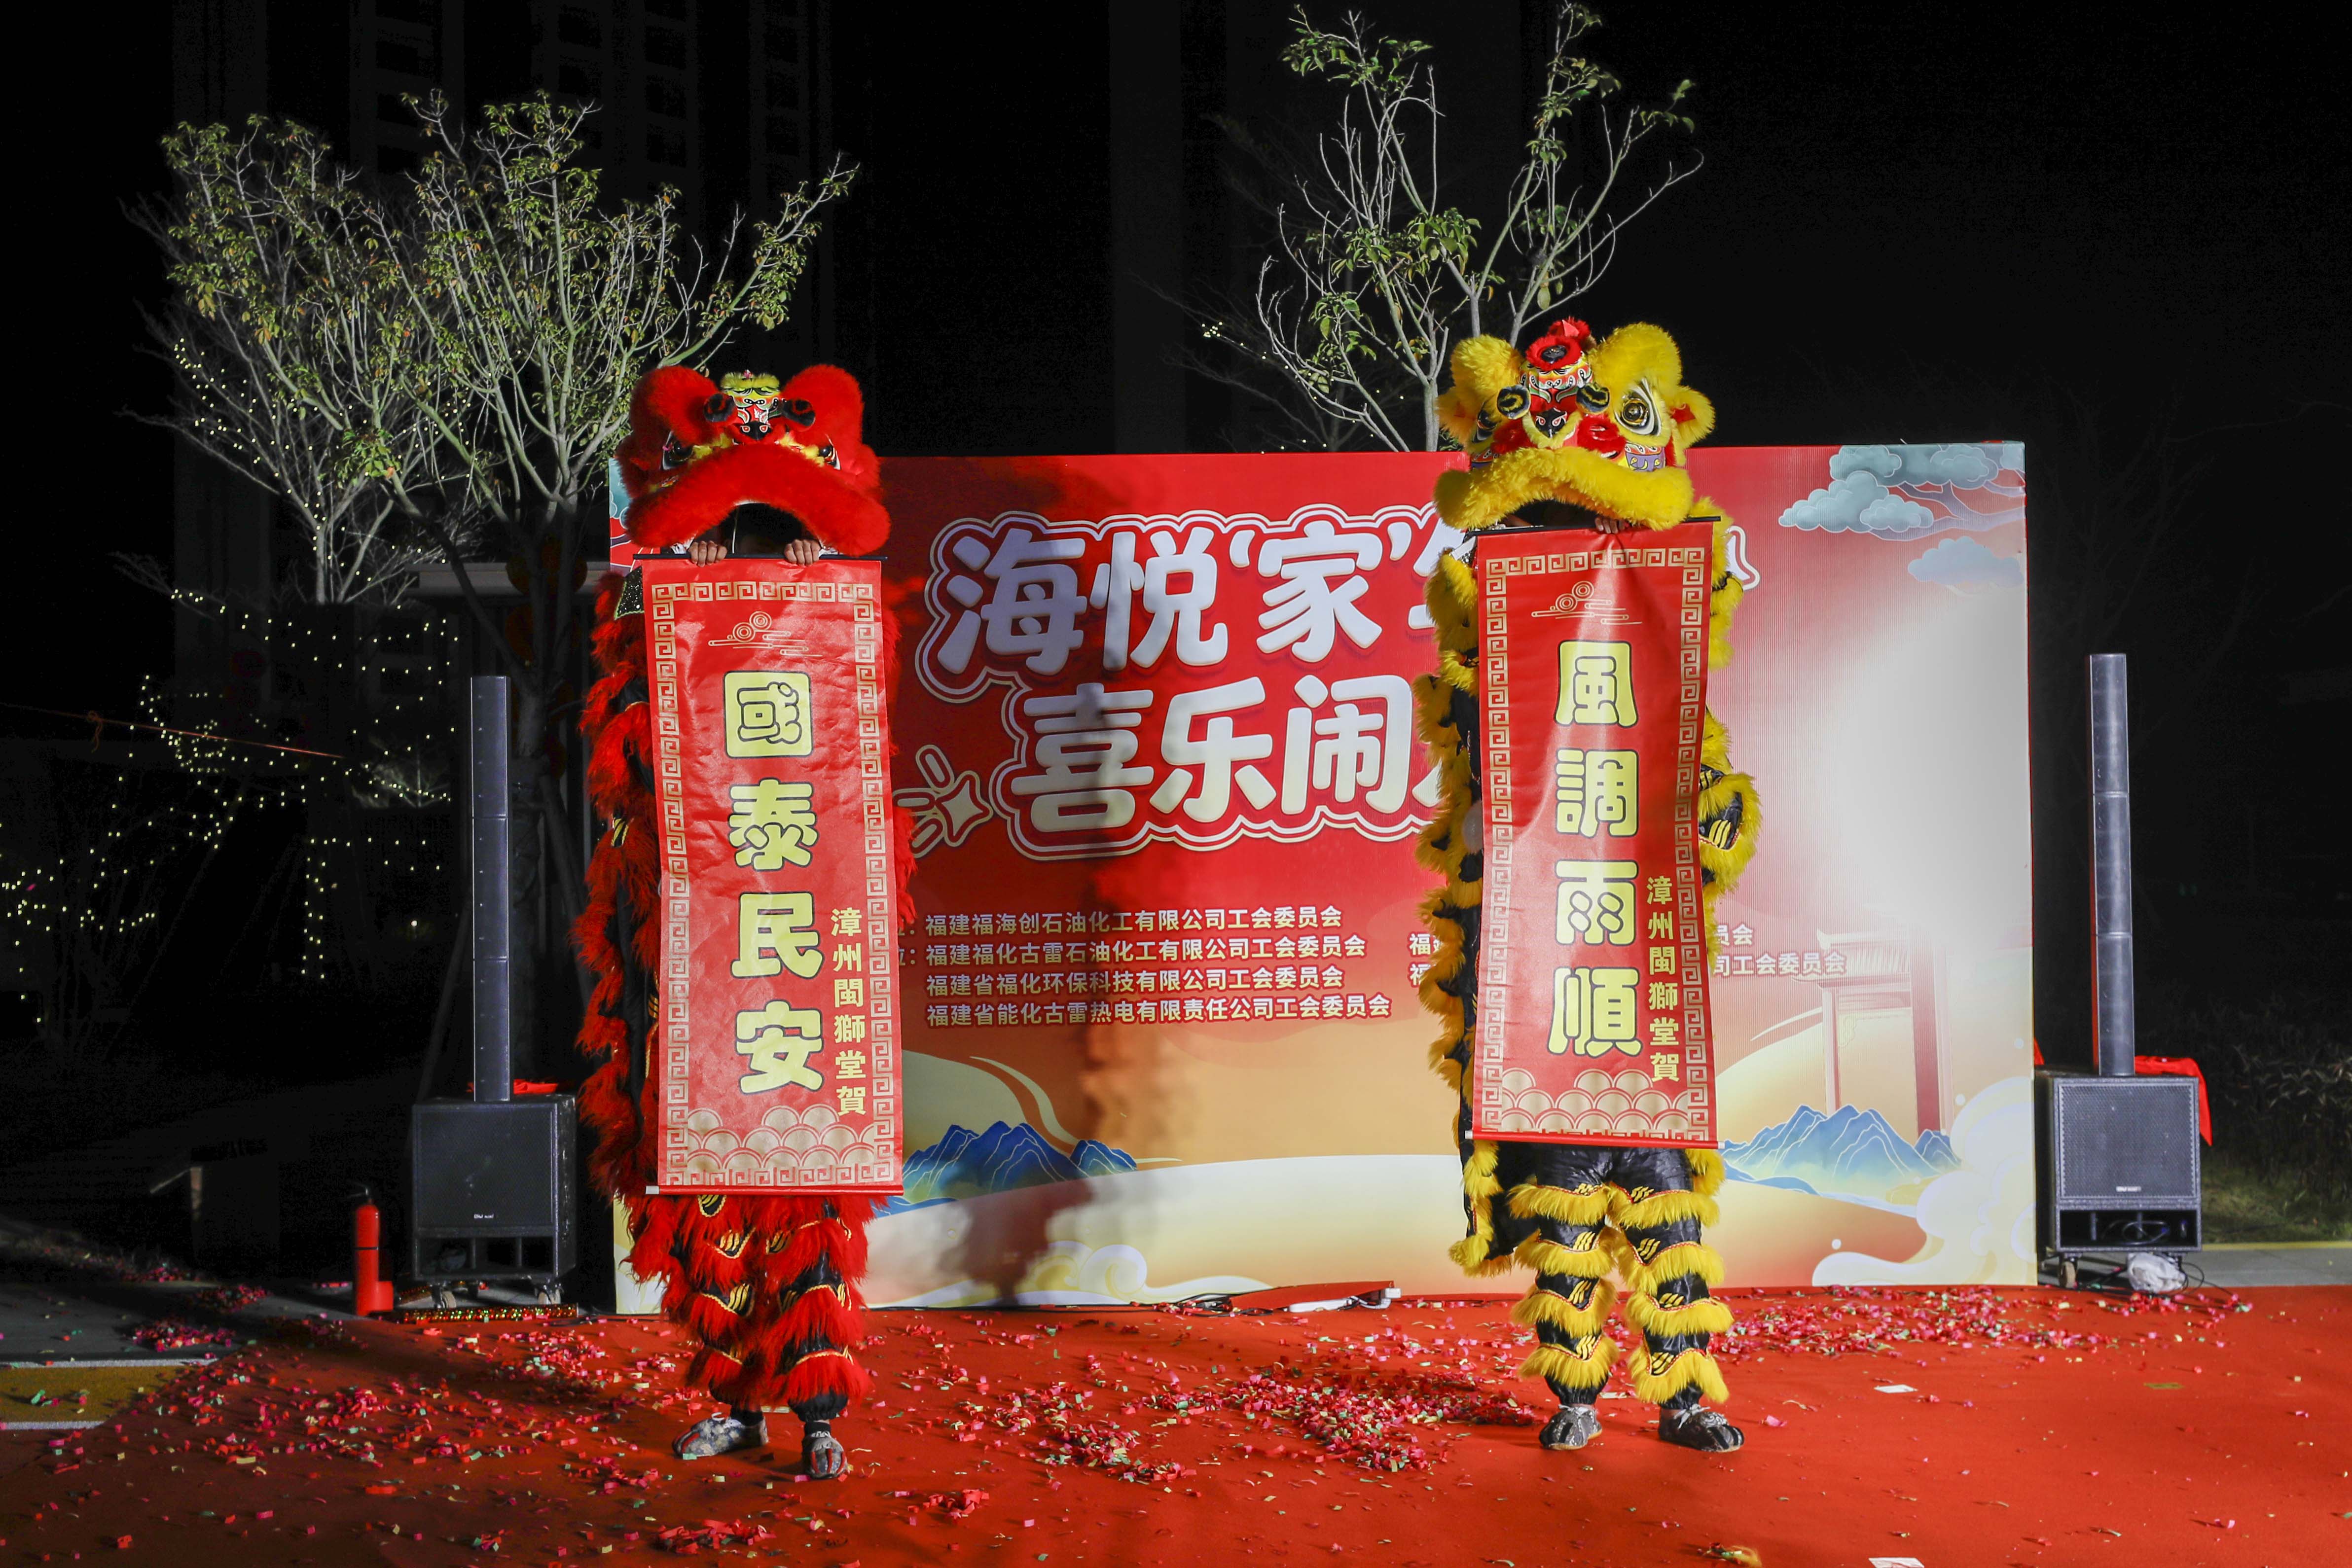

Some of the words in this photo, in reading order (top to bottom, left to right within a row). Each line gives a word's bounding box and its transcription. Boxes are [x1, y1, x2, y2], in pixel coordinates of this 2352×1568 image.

[1012, 674, 1443, 833] 喜乐闹
[1547, 640, 1643, 1059] 風調雨順
[723, 671, 825, 1095] 國泰民安
[927, 965, 1343, 997] 福建省福化环保科技有限公司工会委员会
[1647, 876, 1680, 1083] 漳州閩獅堂賀
[831, 907, 867, 1116] 漳州閩獅堂賀
[927, 994, 1391, 1027] 福建省能化古雷热电有限责任公司工会委员会
